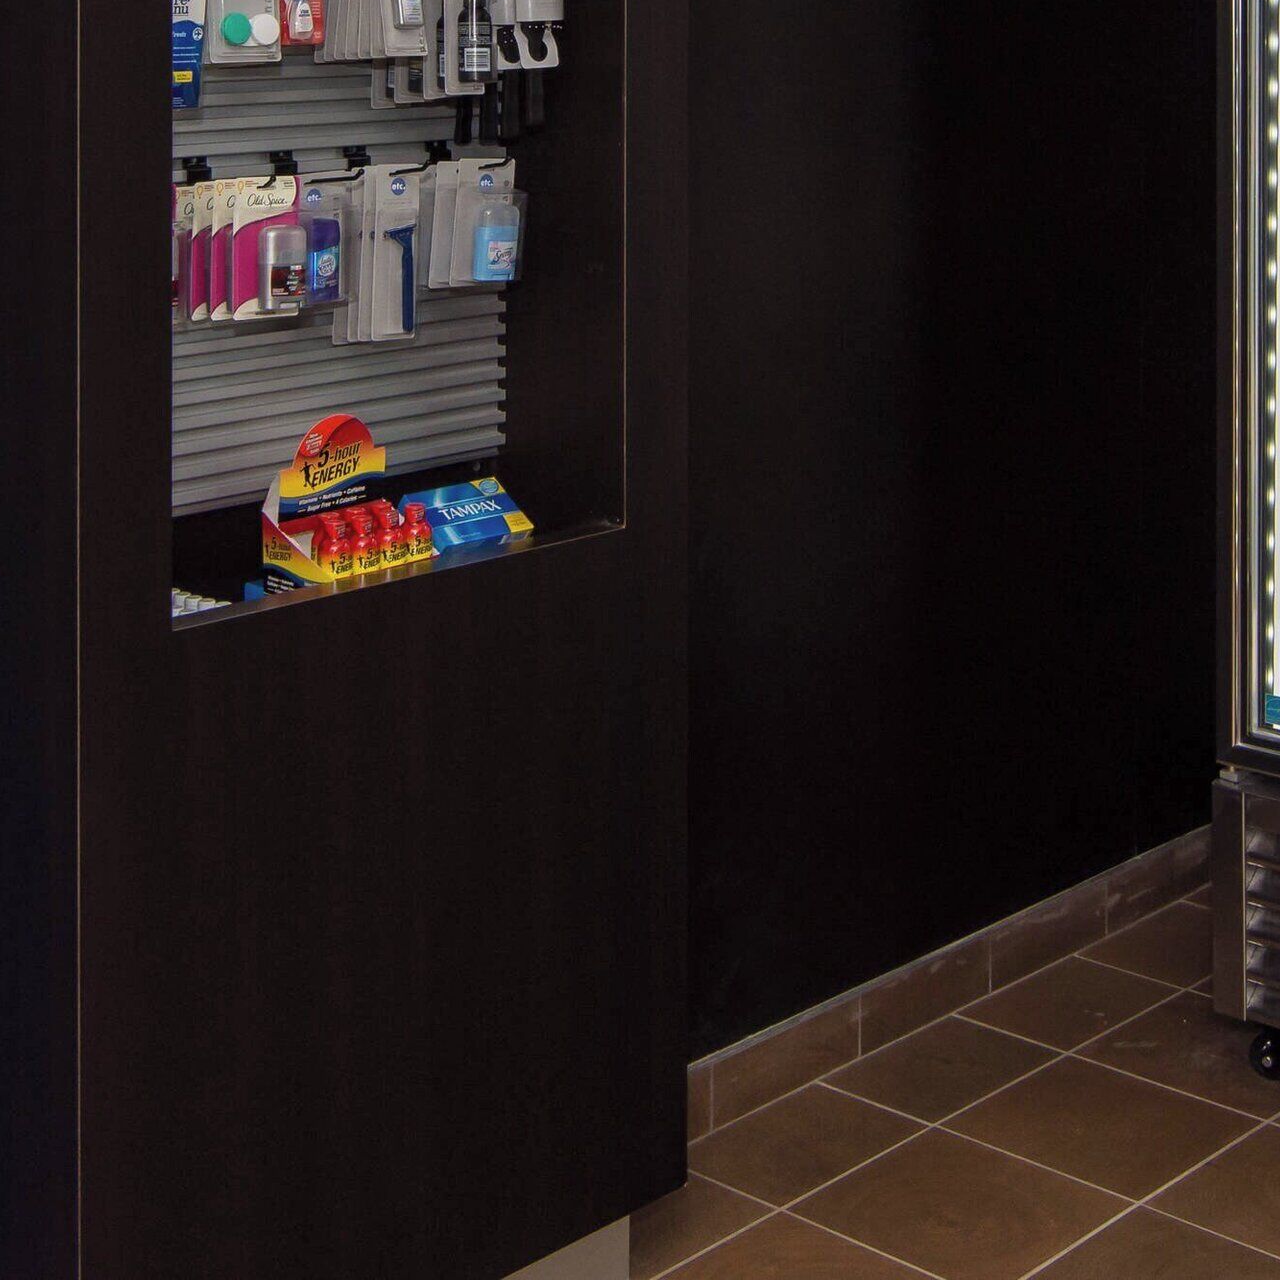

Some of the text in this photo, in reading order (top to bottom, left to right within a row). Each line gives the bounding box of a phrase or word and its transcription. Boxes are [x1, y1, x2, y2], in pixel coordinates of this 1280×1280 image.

[247, 192, 287, 207] Old Spice
[317, 440, 362, 468] 5-hour
[311, 456, 361, 488] ENERGY
[437, 498, 503, 522] TAMPAX
